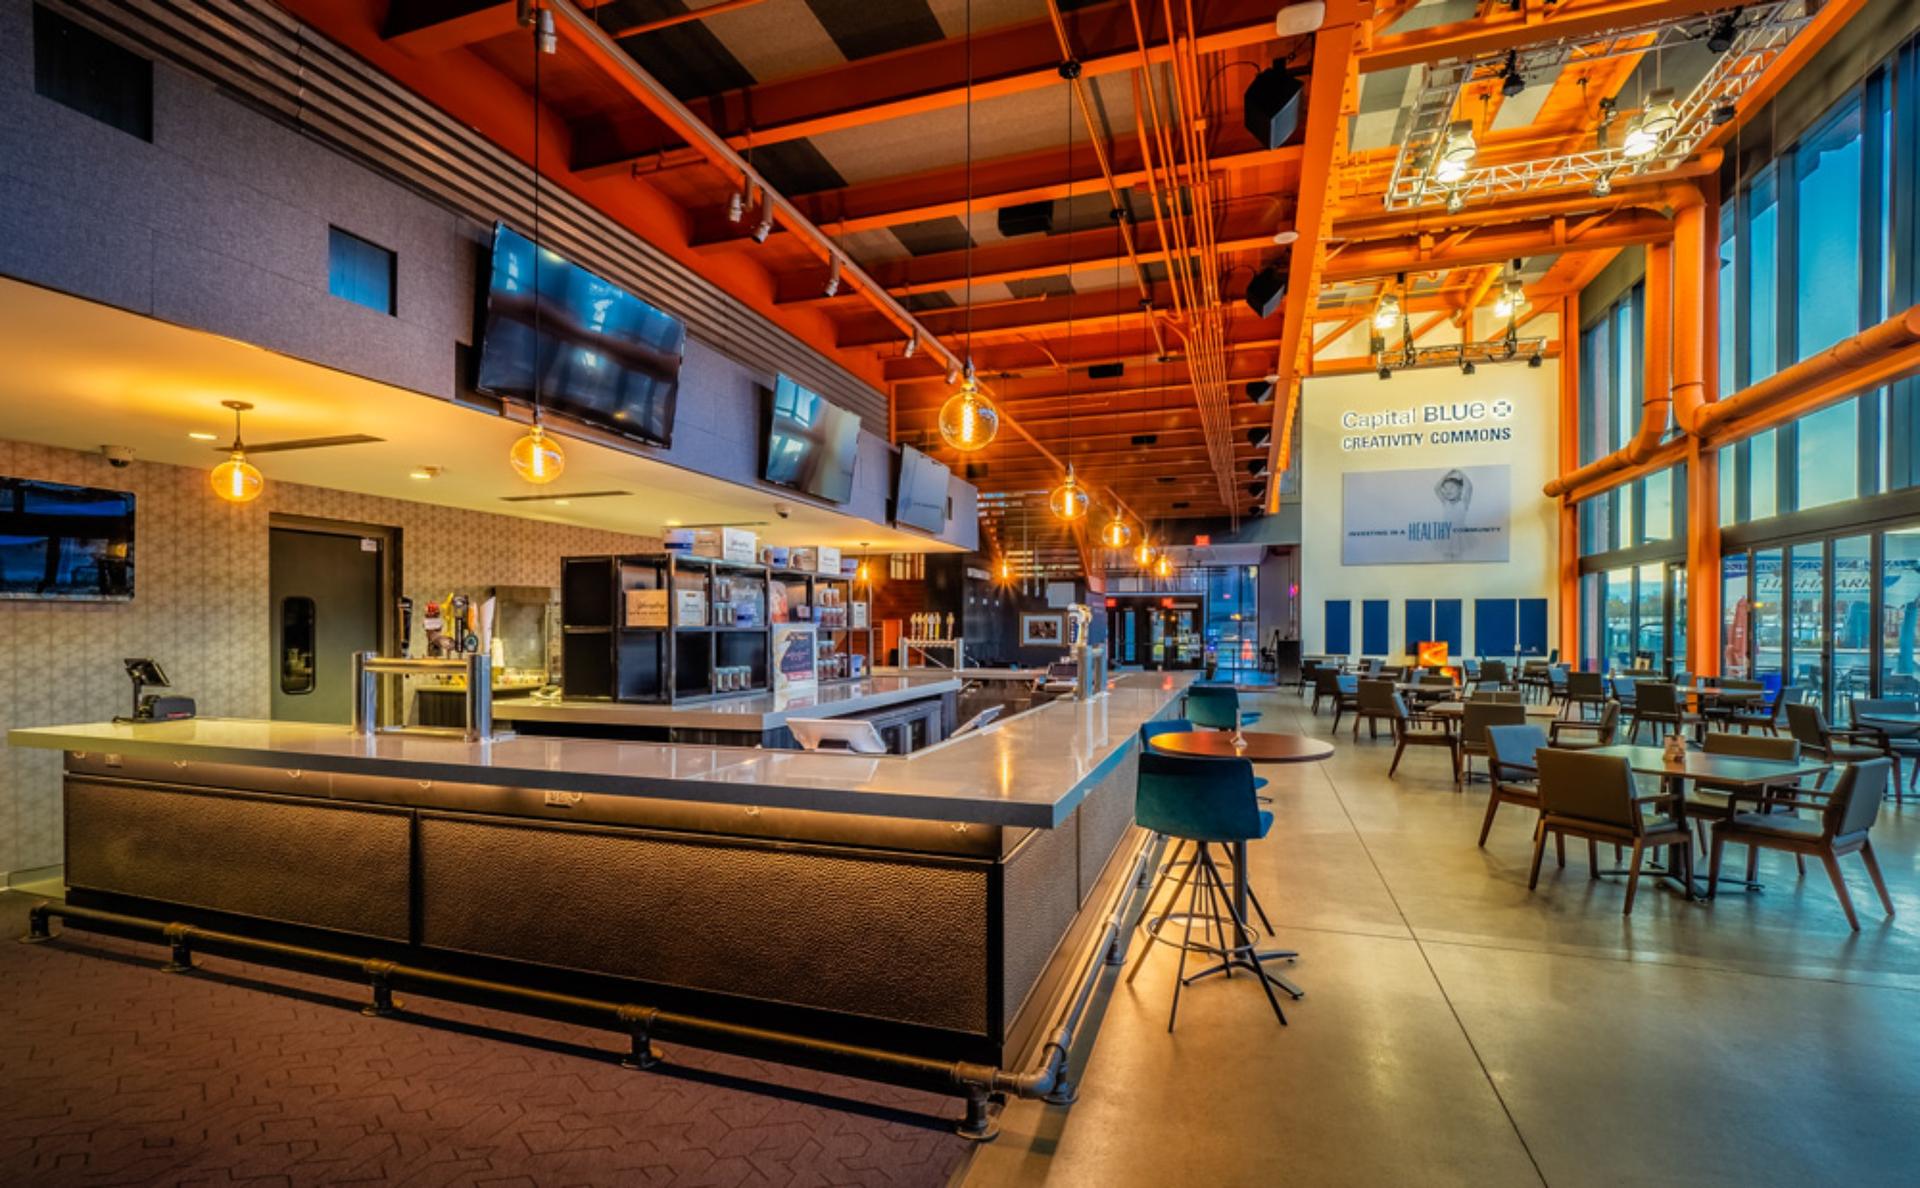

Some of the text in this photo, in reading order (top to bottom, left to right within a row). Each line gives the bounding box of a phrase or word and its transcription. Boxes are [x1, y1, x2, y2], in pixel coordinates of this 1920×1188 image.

[1343, 409, 1416, 429] Capital
[1343, 428, 1511, 449] CREATIVITY COMMONS
[1408, 521, 1453, 541] HEALTHY
